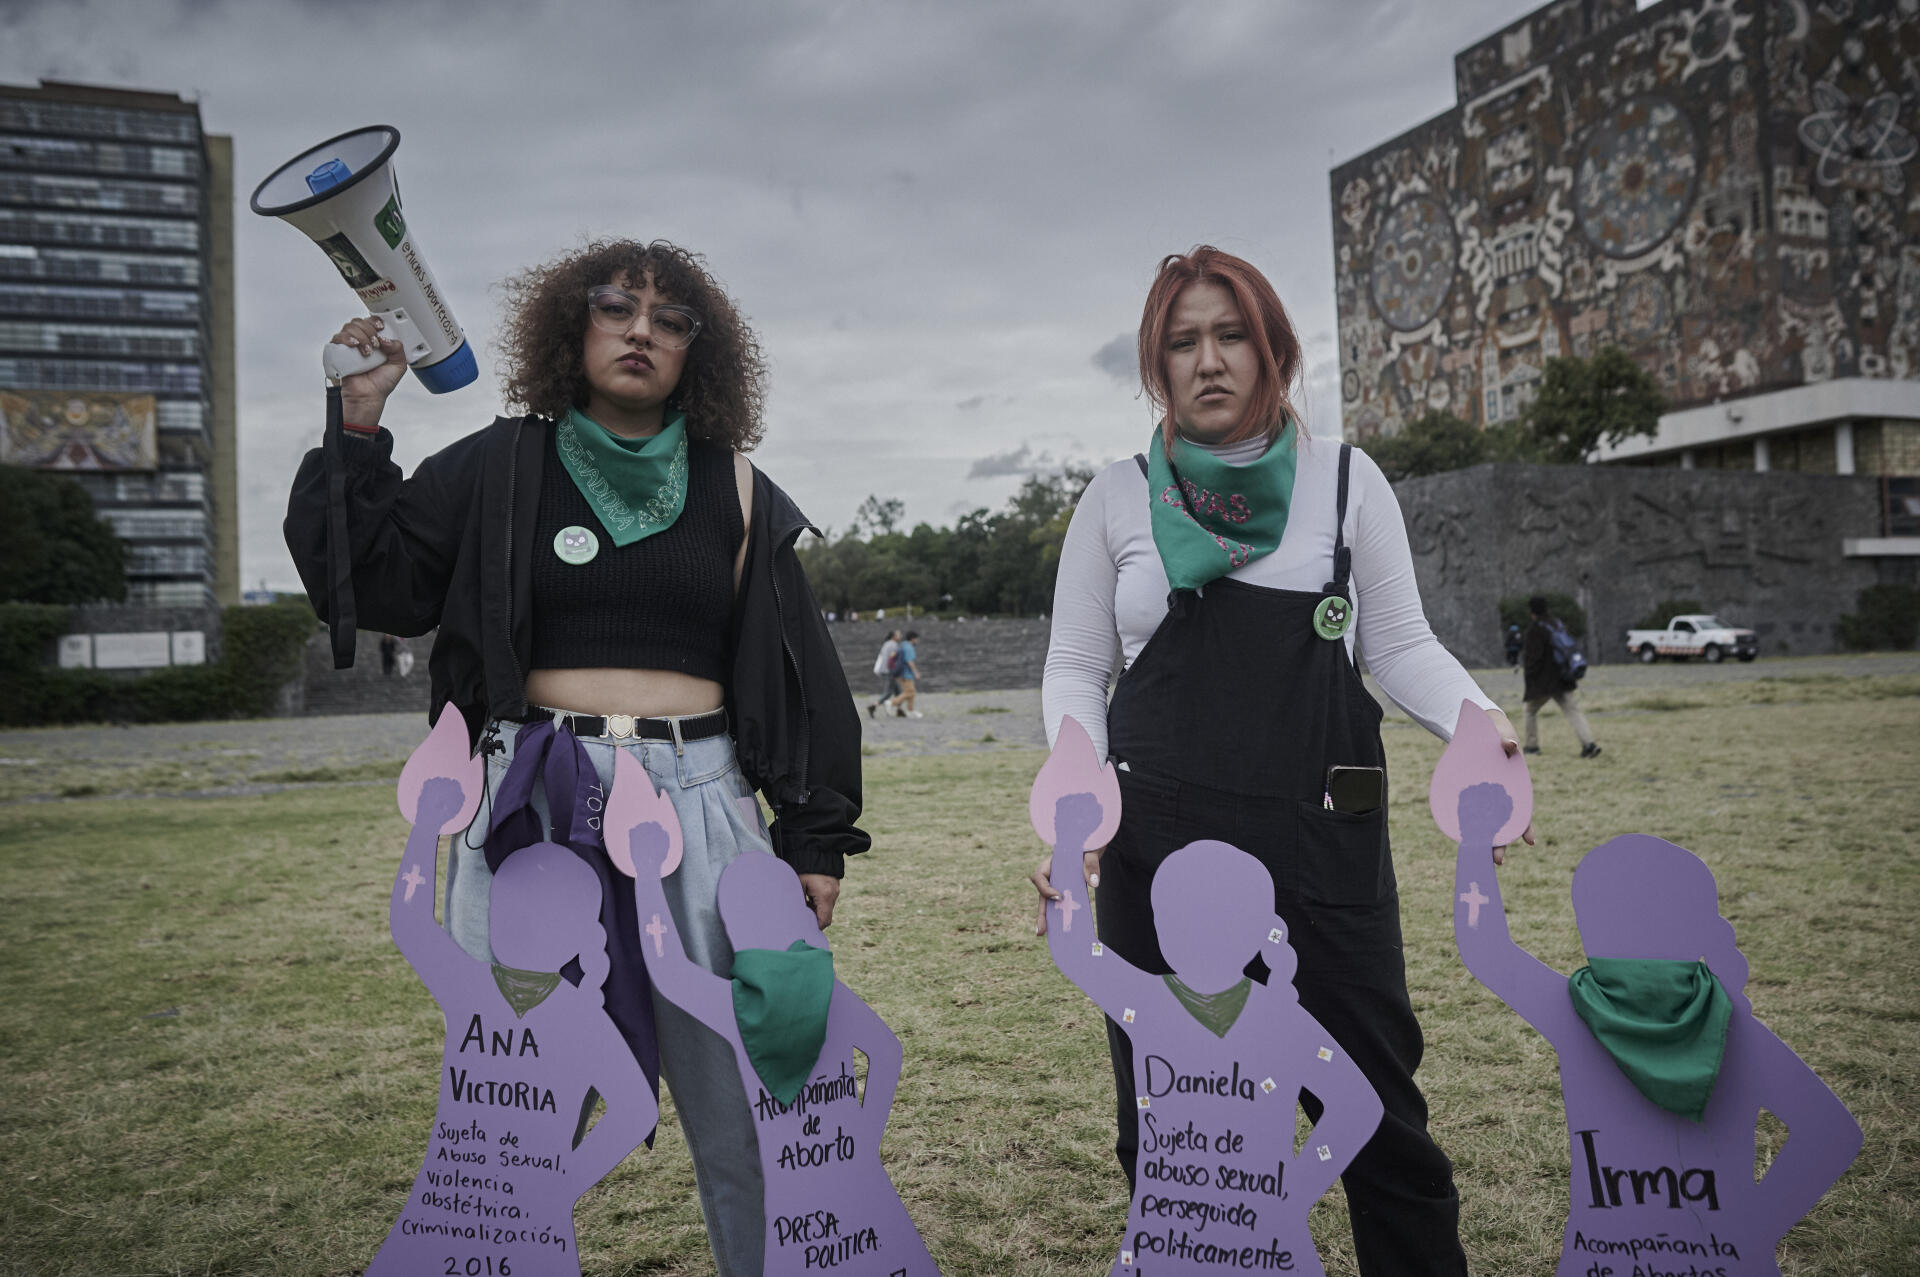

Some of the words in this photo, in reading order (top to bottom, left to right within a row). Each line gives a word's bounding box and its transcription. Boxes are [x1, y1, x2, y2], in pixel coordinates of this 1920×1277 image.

[459, 1013, 539, 1058] ANA
[449, 1066, 556, 1114] VICTORIA
[1145, 1055, 1255, 1101] Daniela
[437, 1119, 486, 1144] Sujeta
[499, 1131, 519, 1148] de
[802, 1113, 821, 1136] de
[1143, 1112, 1208, 1155] Sujeta
[1214, 1129, 1244, 1154] de
[437, 1147, 487, 1166] Abuso
[776, 1126, 855, 1170] Aborto
[1143, 1156, 1210, 1186] abuso
[1215, 1160, 1288, 1201] sexual,
[1574, 1129, 1721, 1211] Irma
[1140, 1193, 1257, 1232] perseguida
[402, 1219, 567, 1252] Criminalización
[1574, 1230, 1741, 1262] Acompañanta
[444, 1256, 512, 1277] 2016
[1586, 1261, 1621, 1277] de
